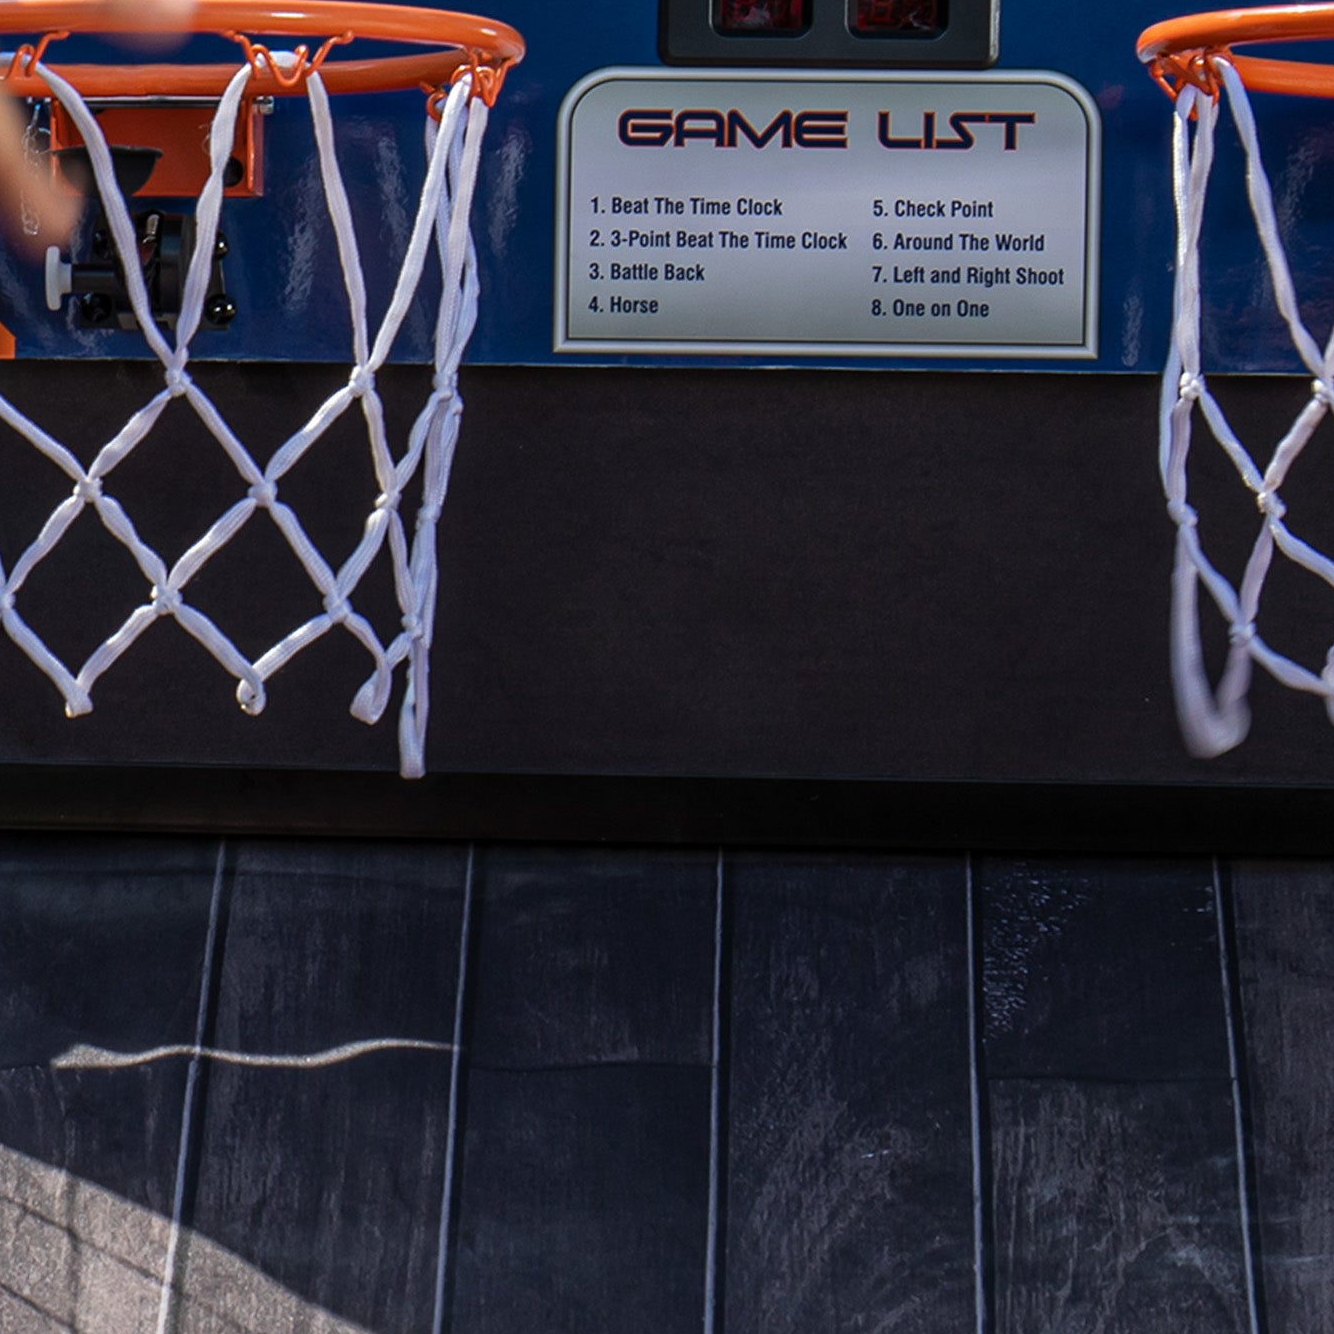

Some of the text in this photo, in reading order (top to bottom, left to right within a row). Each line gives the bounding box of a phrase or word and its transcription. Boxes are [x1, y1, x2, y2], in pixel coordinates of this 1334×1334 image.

[618, 109, 1036, 151] GAME LIST
[590, 197, 782, 216] 1. Beat The Time Clock
[873, 200, 994, 217] 5. Check Point
[589, 230, 847, 249] 2. 3-Point Beat The Time Clock
[873, 233, 1045, 251] 6. Around The World
[589, 263, 705, 281] 3. Battle Back
[872, 266, 1064, 287] 7. Left and Right Shoot
[589, 296, 659, 313] 4. Horse
[872, 299, 989, 317] 8. One on One
